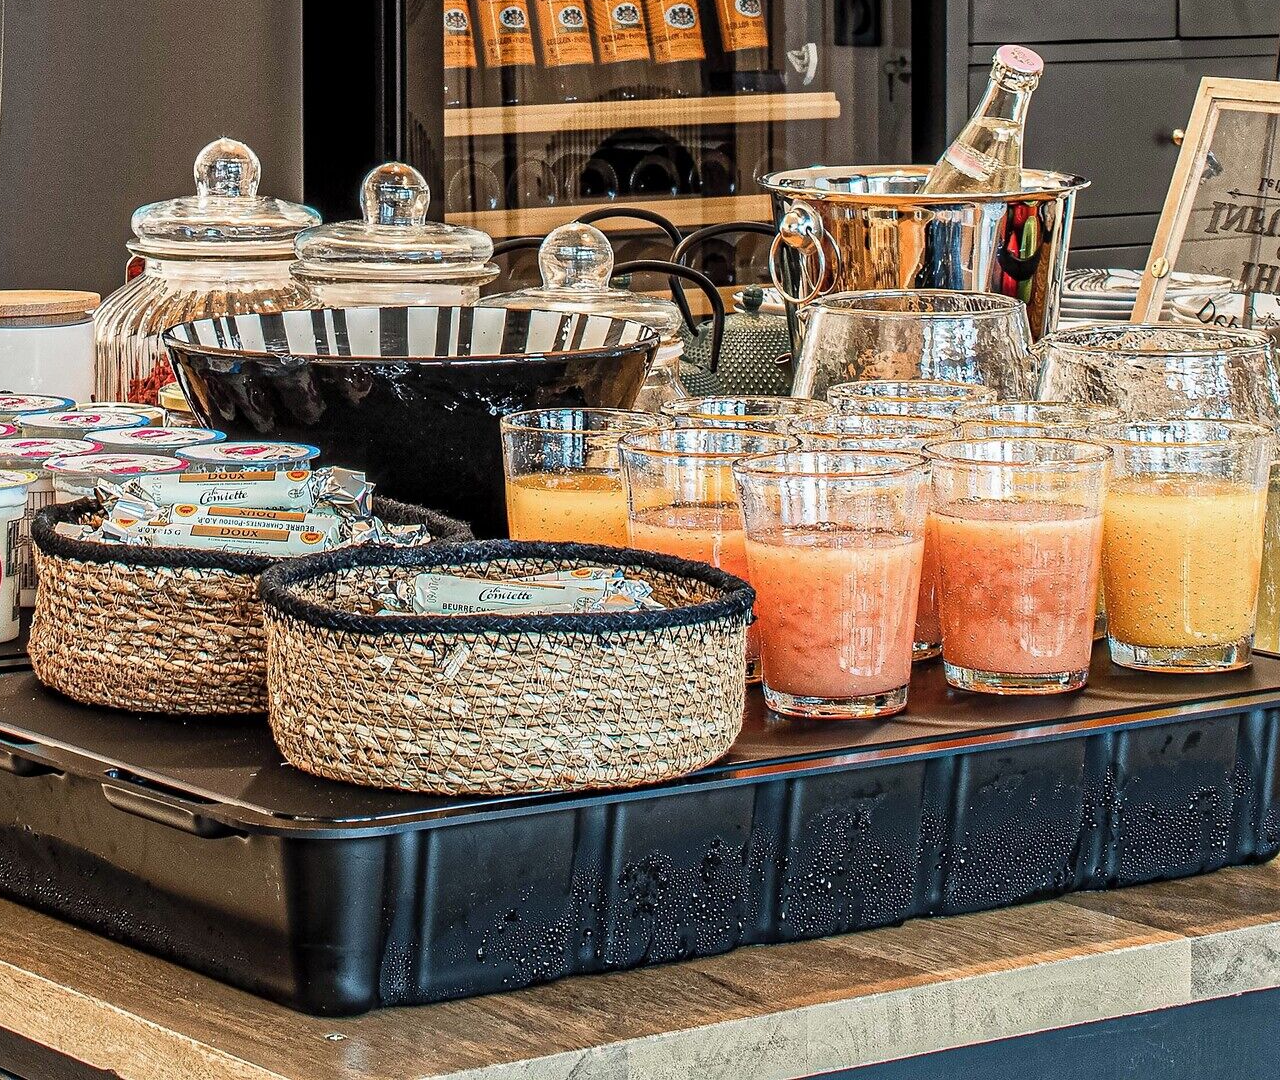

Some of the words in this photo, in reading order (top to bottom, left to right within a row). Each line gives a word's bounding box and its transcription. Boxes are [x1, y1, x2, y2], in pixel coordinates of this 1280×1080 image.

[207, 472, 245, 480] DOUX
[239, 509, 277, 518] DOUX
[220, 527, 258, 537] DOUX
[285, 523, 315, 532] BEURRE
[442, 602, 474, 613] BEURRE
